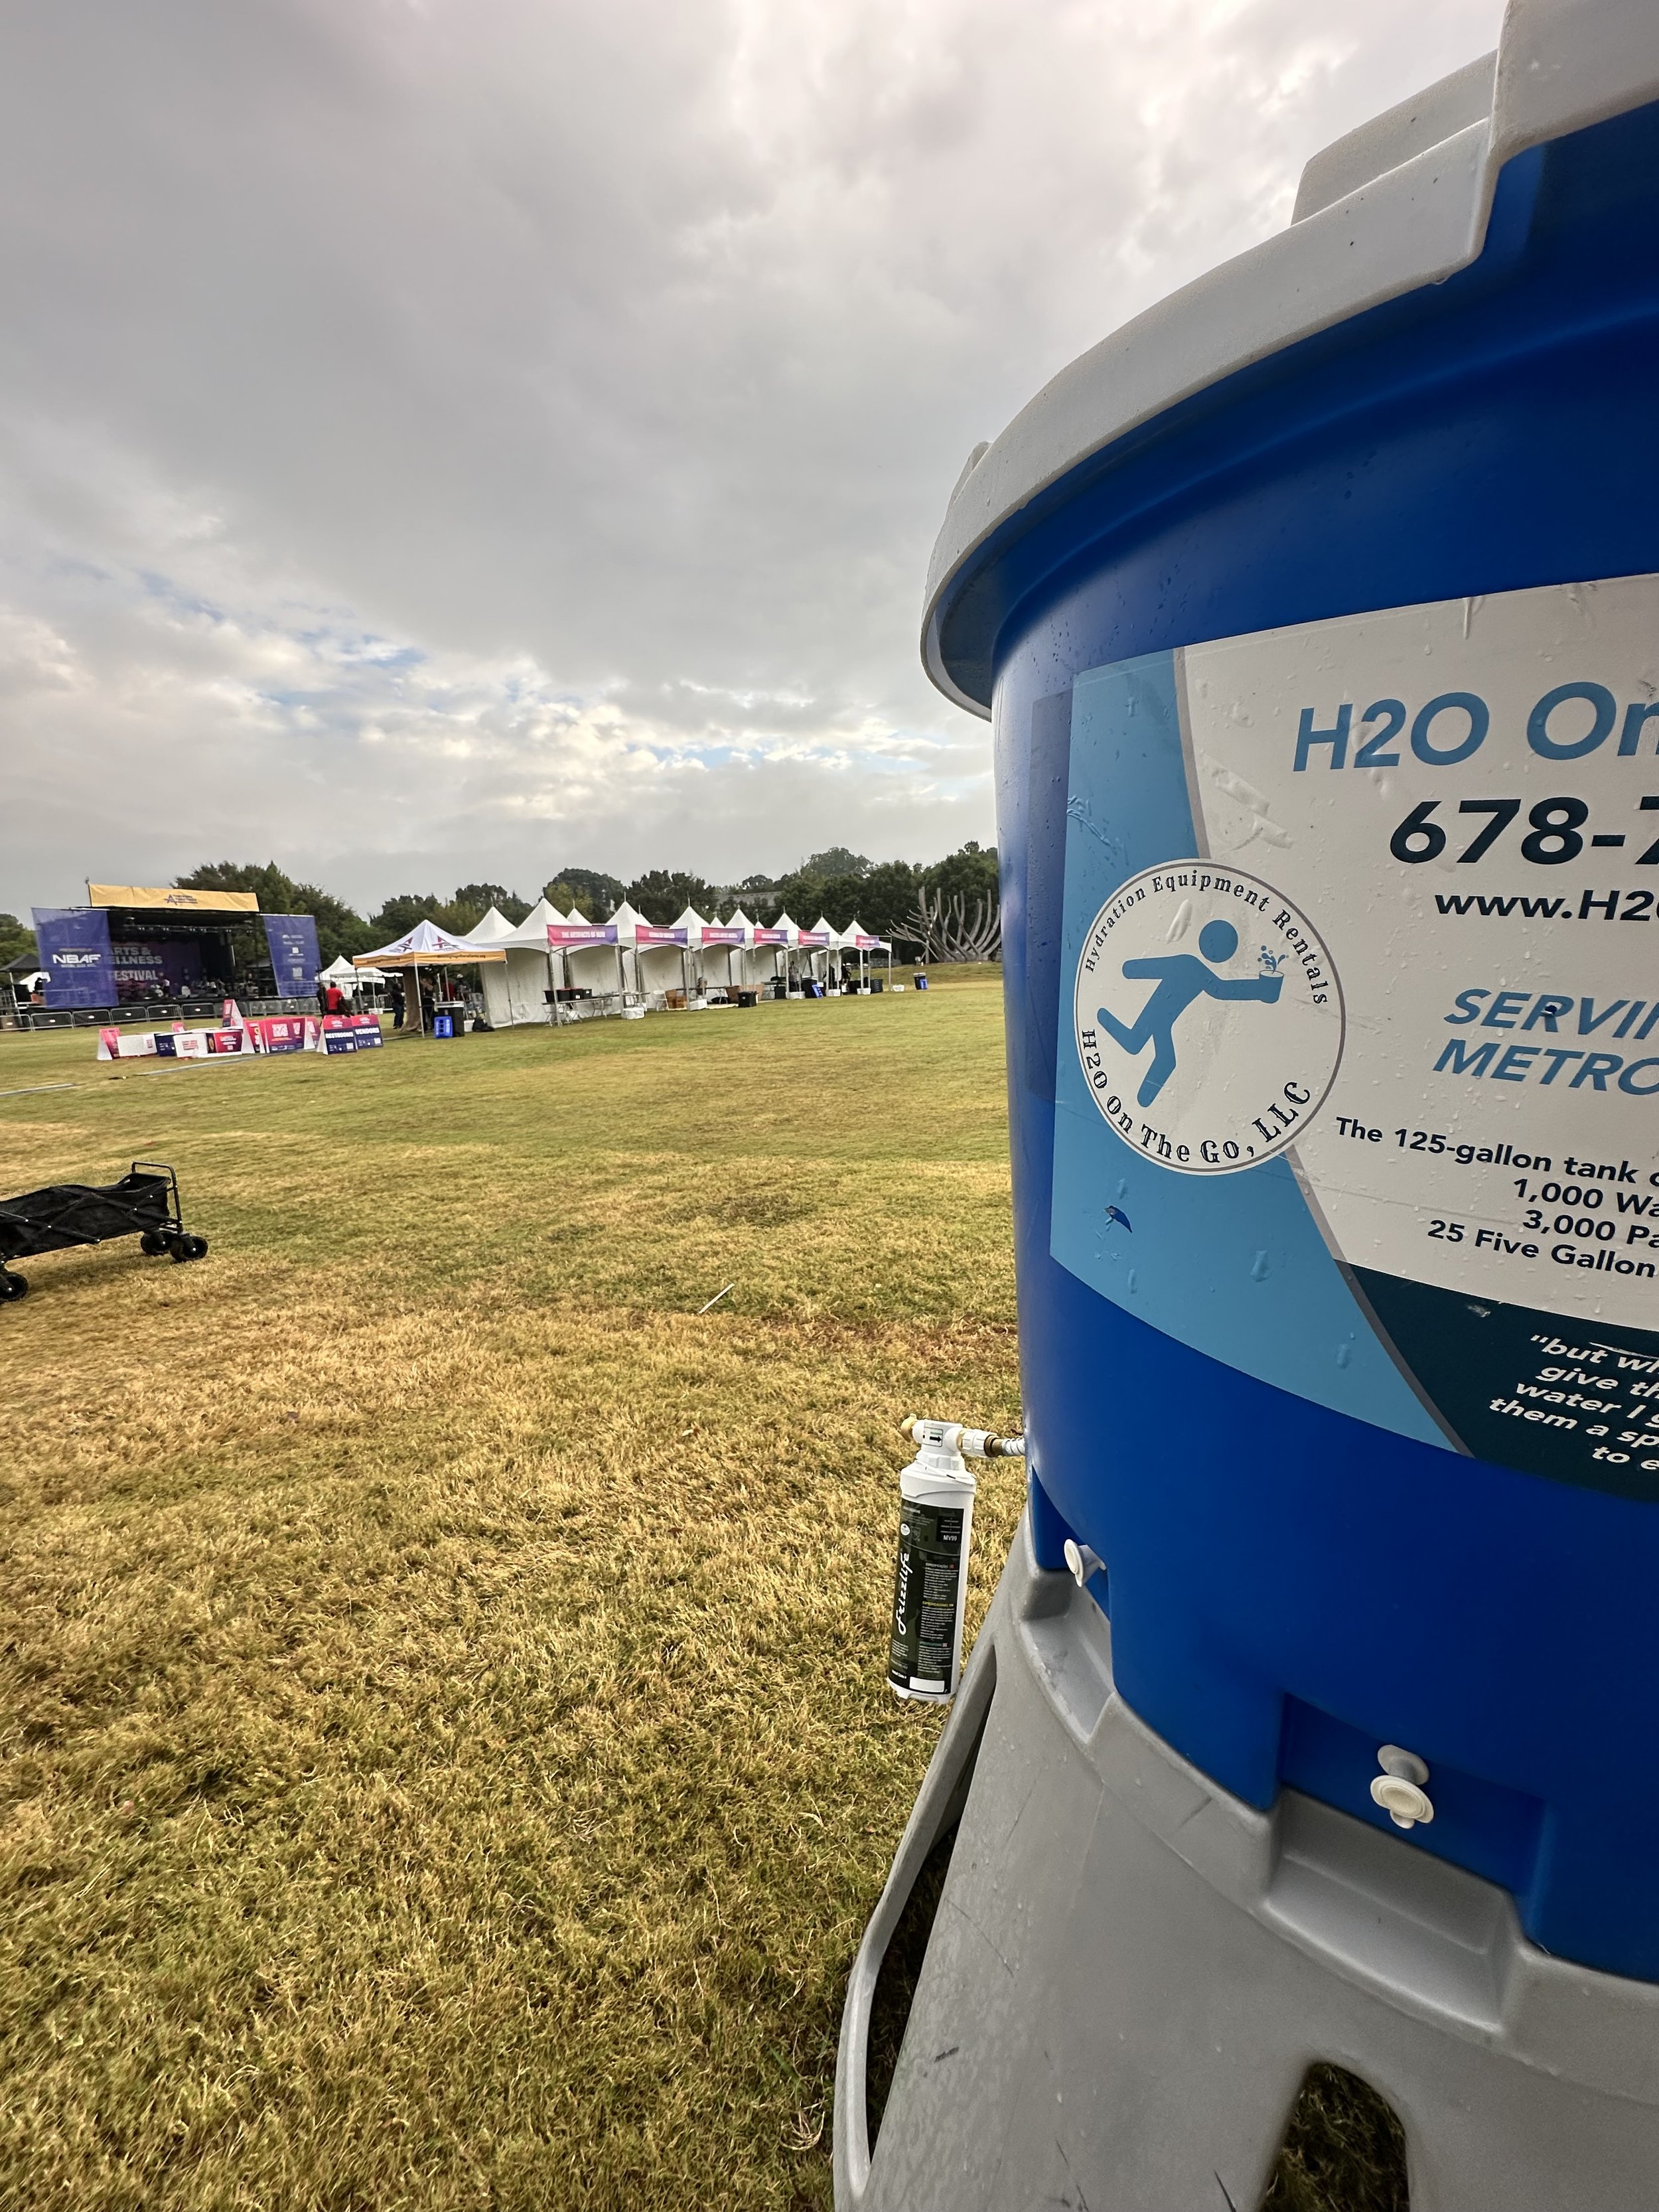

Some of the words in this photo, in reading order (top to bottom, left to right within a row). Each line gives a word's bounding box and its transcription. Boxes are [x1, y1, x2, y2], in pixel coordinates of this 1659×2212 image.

[1293, 692, 1490, 772] H2O
[1527, 682, 1659, 761] On
[1435, 889, 1659, 922] www.H2
[1084, 885, 1147, 973] Hydration
[1152, 869, 1270, 913] Equipment
[1272, 909, 1329, 1005] Rentals
[52, 954, 101, 964] NBAF
[108, 956, 163, 964] ELLNESS
[1106, 1095, 1133, 1134] On
[1140, 1124, 1190, 1163] The
[1200, 1140, 1254, 1163] Go,
[1252, 1081, 1311, 1143] LLC
[1336, 1116, 1383, 1143] The
[1394, 1128, 1552, 1172] 125-gallon
[1563, 1156, 1640, 1184] tank
[1514, 1179, 1603, 1209] 1,000
[1522, 1209, 1616, 1242] 3,000
[1427, 1220, 1465, 1243] 25
[1475, 1228, 1539, 1258] Five
[1551, 1244, 1655, 1278] Gallon
[1535, 1367, 1619, 1390] give
[1516, 1383, 1622, 1414] water
[1626, 1404, 1646, 1419] I
[1489, 1398, 1578, 1430] them
[1586, 1425, 1609, 1437] a
[1616, 1431, 1659, 1448] sp
[1592, 1447, 1630, 1463] to
